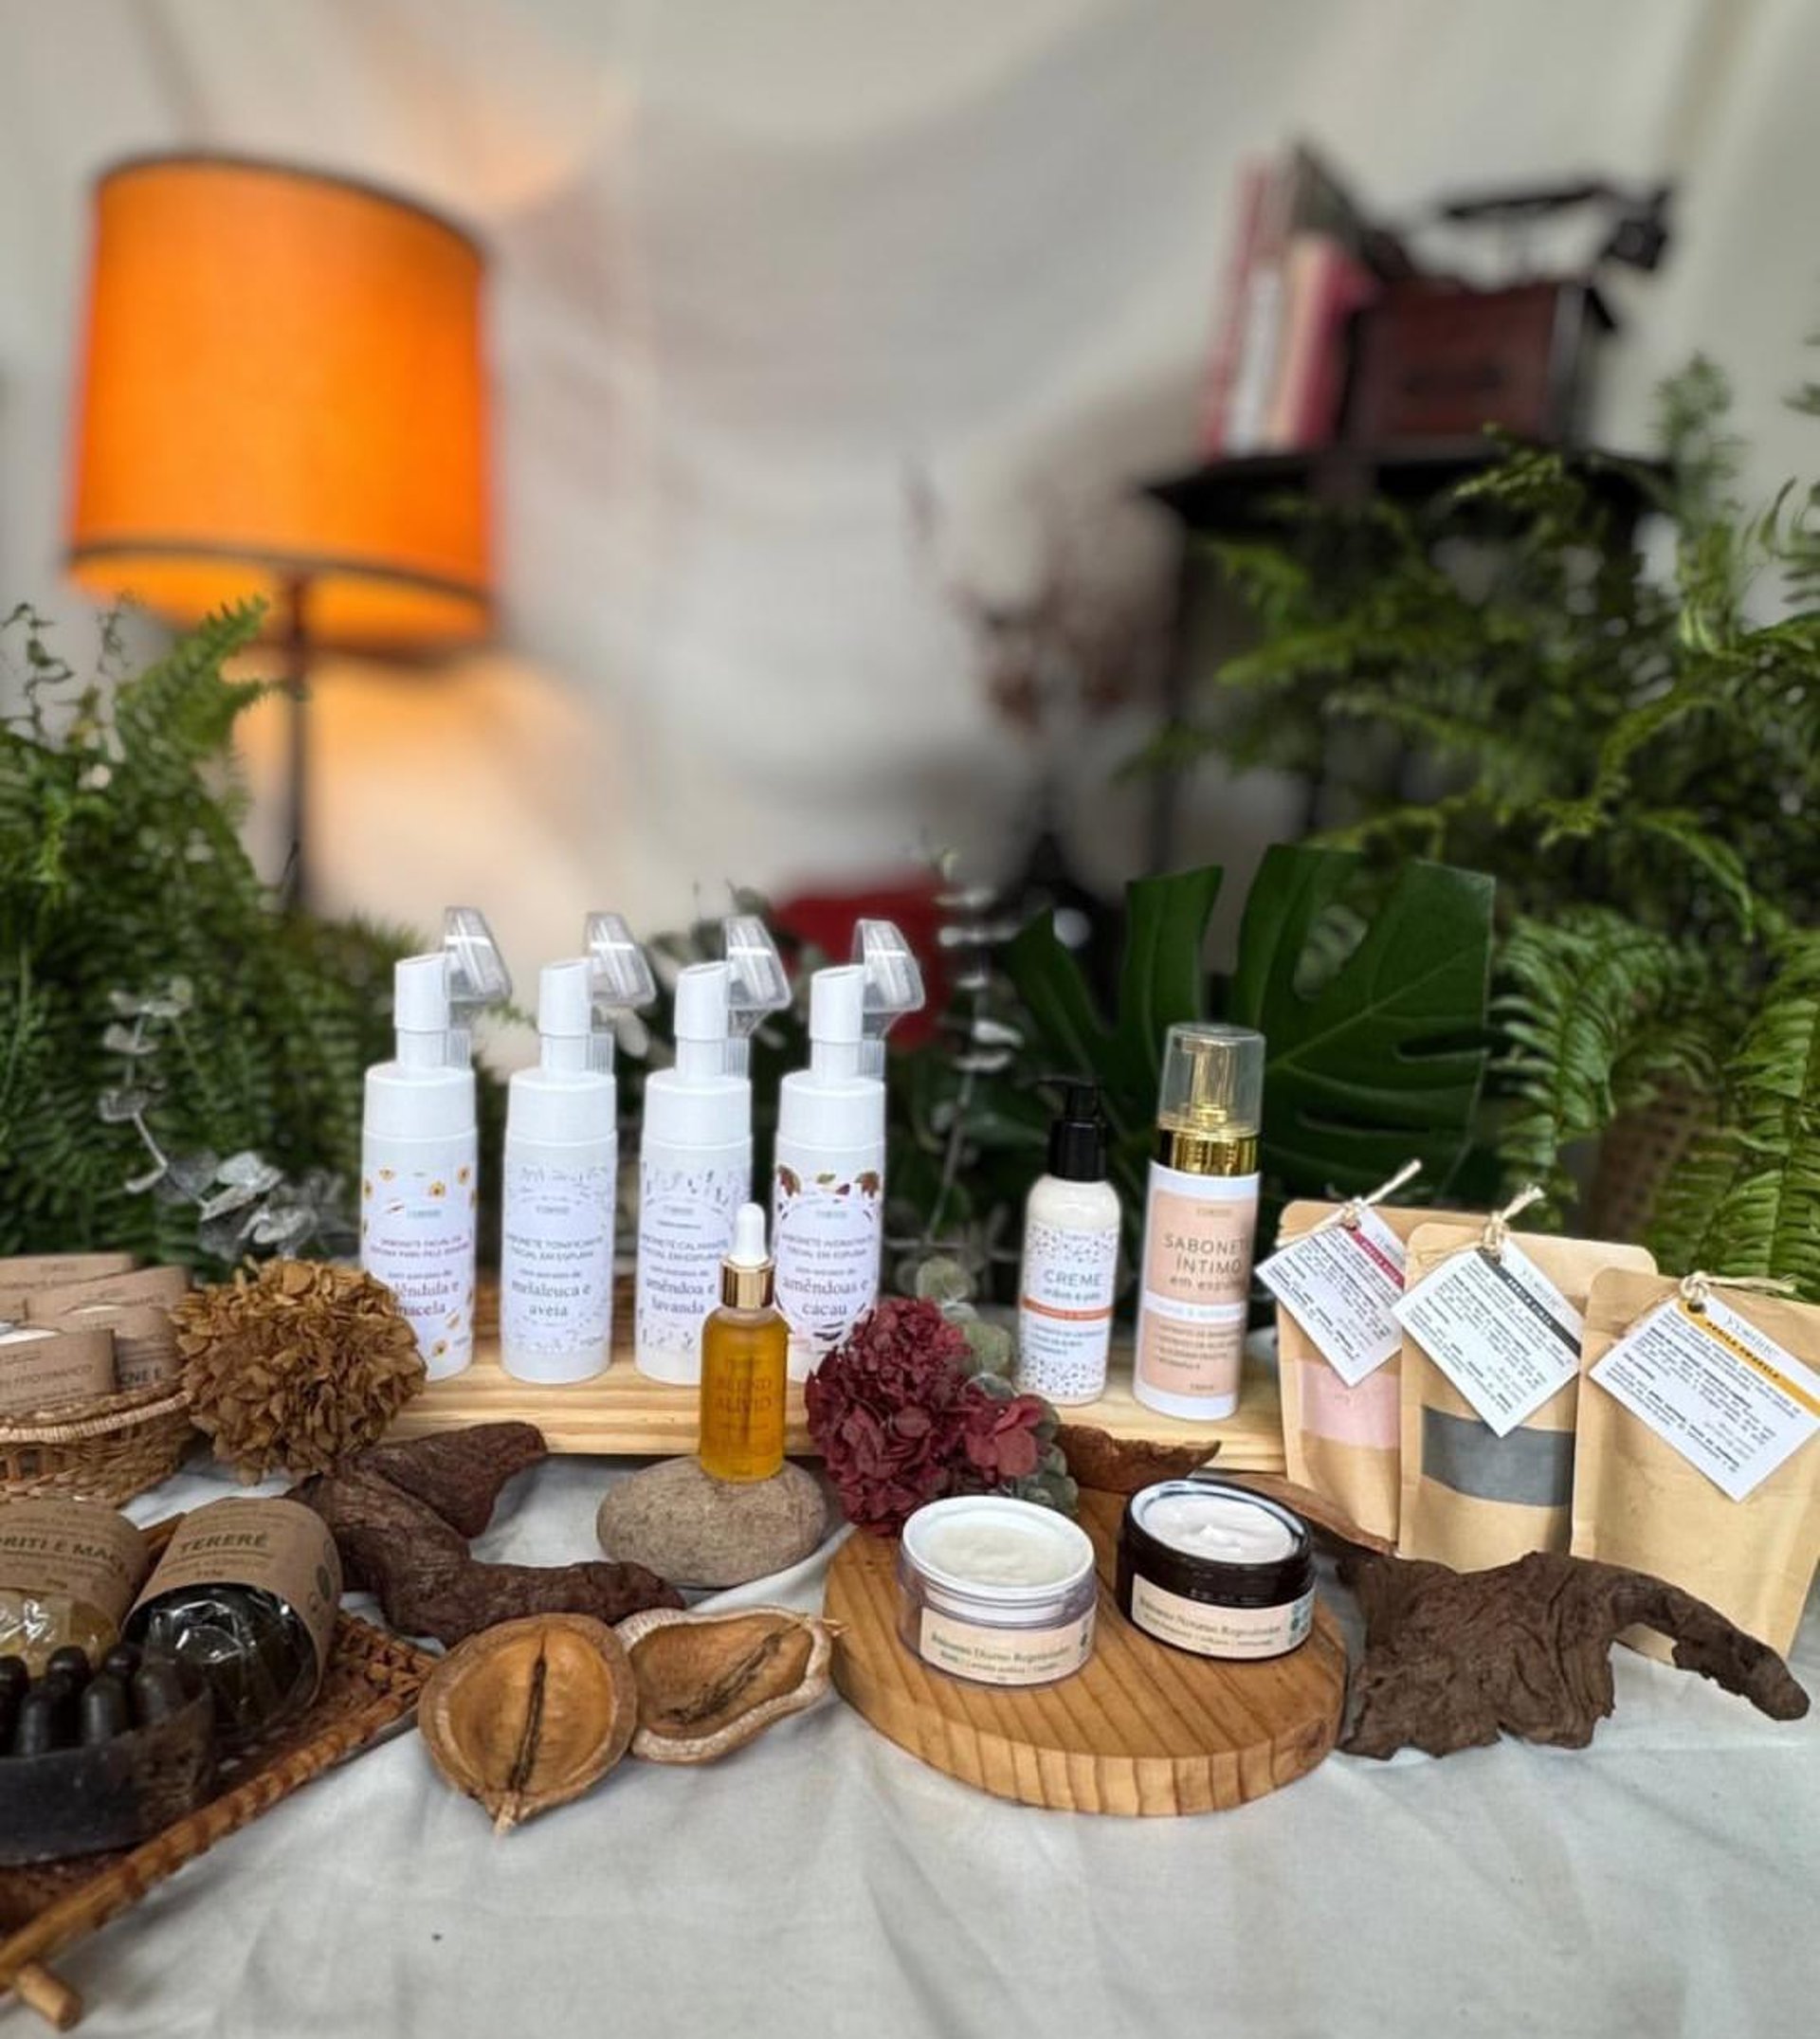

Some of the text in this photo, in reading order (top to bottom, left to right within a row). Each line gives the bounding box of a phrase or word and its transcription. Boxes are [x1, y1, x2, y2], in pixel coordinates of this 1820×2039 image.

[1162, 1232, 1248, 1255] SABONET
[1044, 1269, 1102, 1288] CREME
[801, 1302, 847, 1316] cacau
[180, 1530, 268, 1554] TERERÉ
